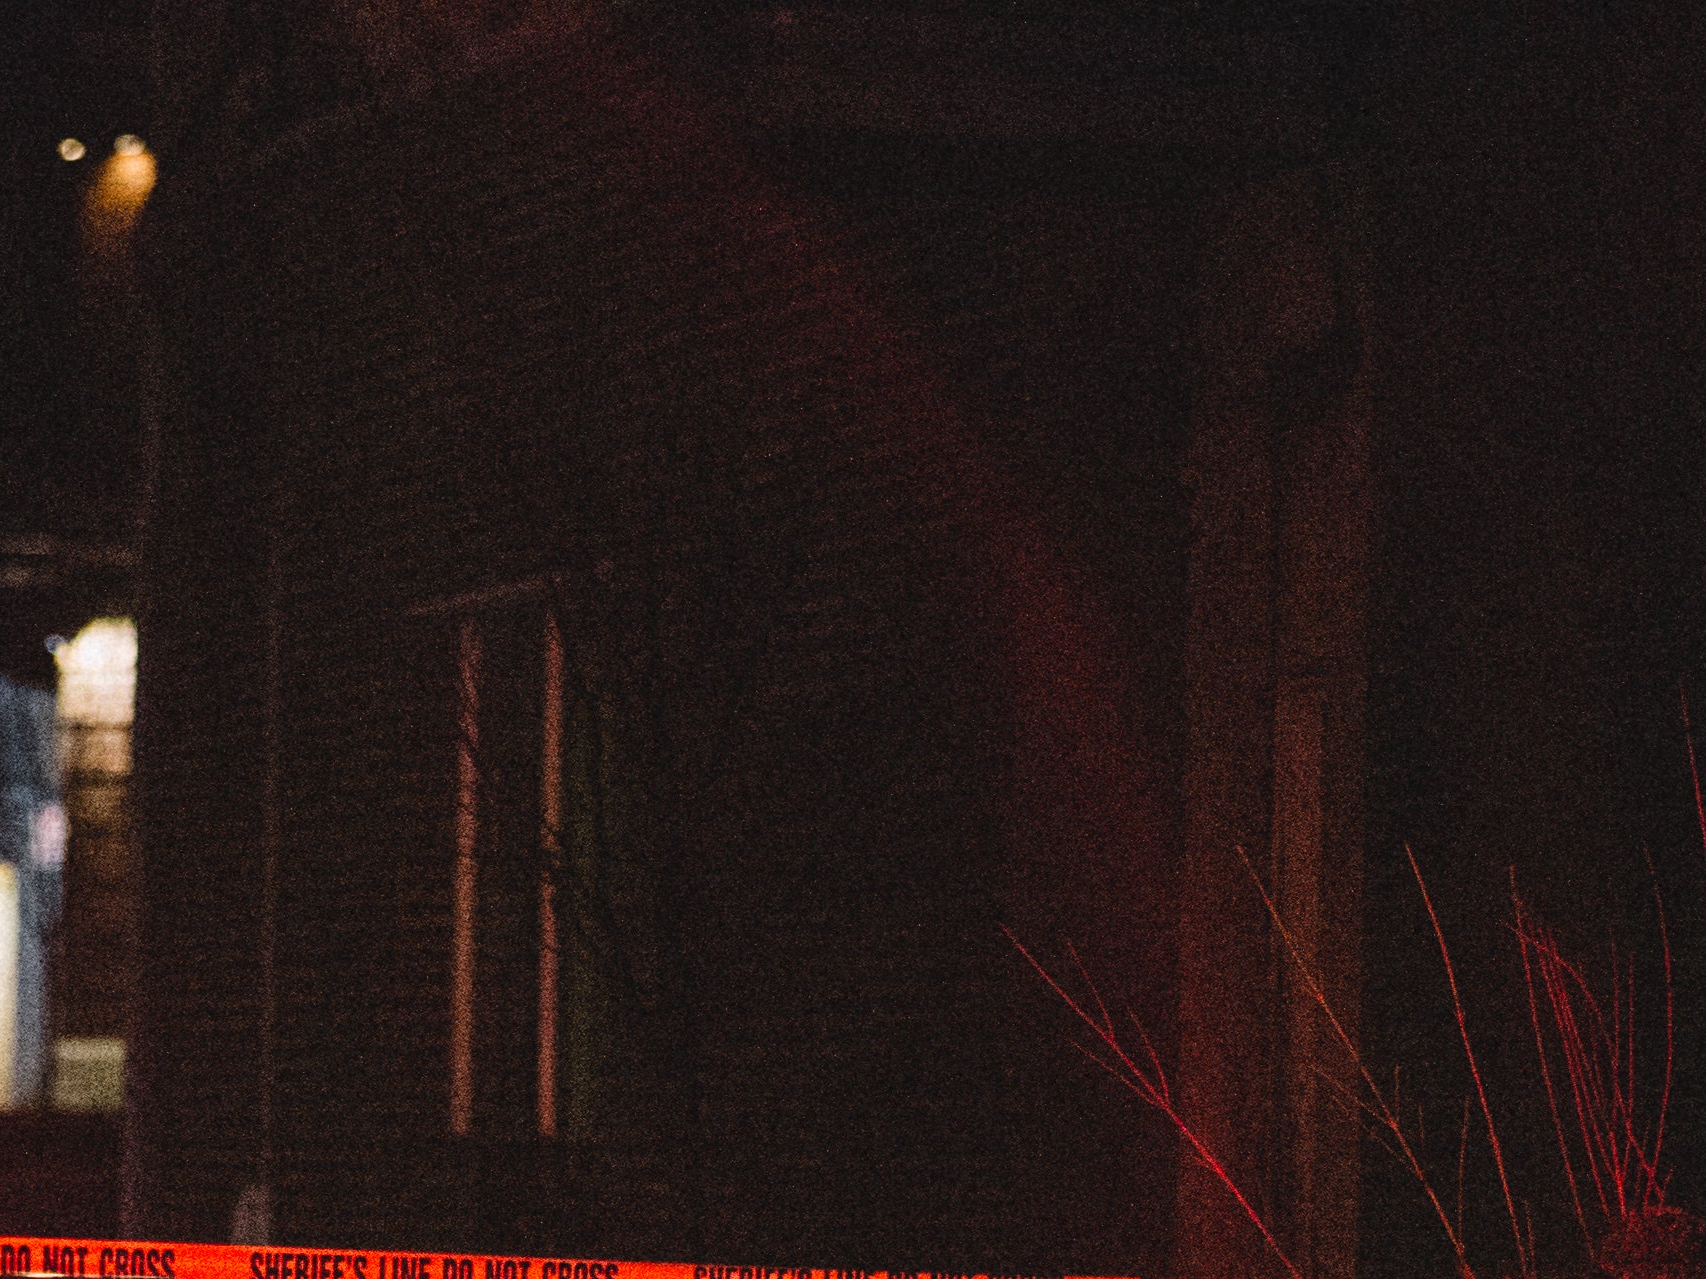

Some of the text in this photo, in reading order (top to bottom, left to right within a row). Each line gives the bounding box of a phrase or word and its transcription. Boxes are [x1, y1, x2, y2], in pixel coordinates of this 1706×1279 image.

[0, 1243, 32, 1277] DO
[42, 1245, 87, 1278] NOT
[99, 1247, 175, 1279] CROSS
